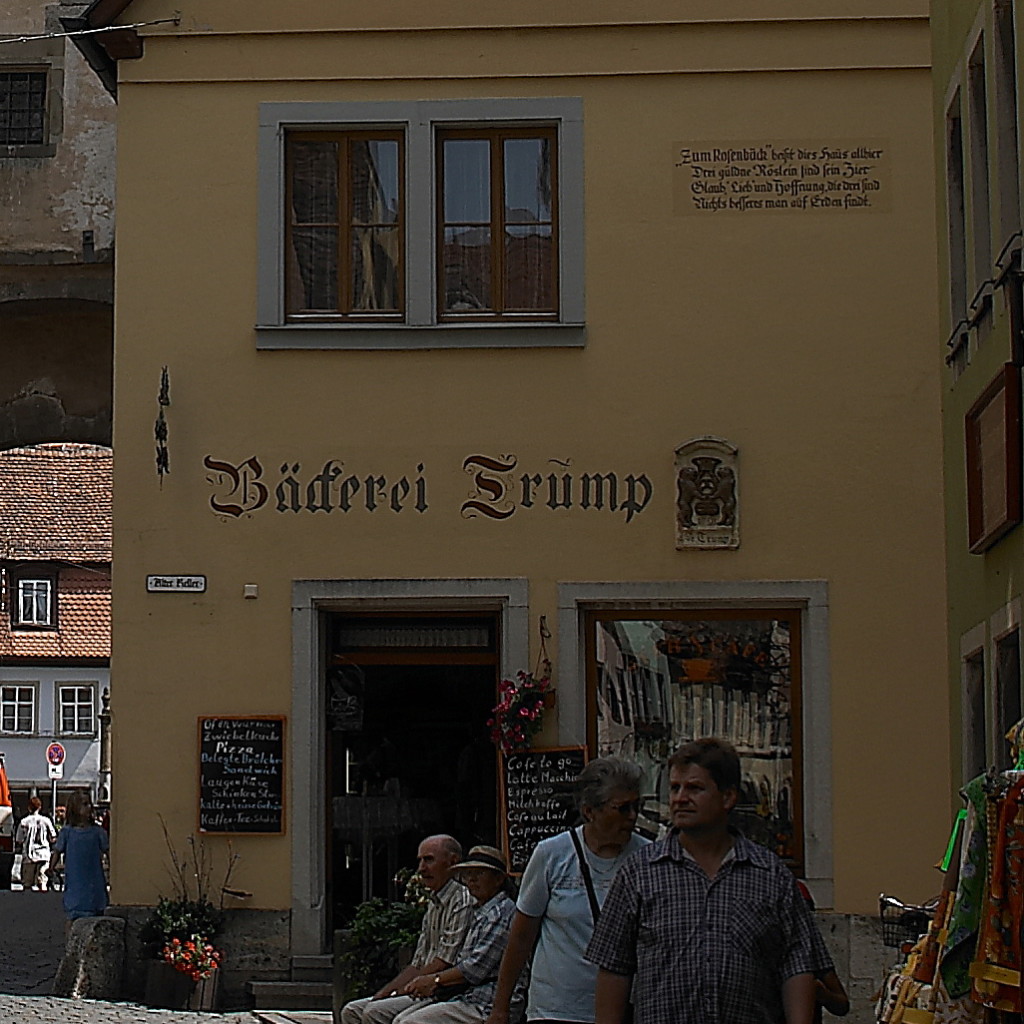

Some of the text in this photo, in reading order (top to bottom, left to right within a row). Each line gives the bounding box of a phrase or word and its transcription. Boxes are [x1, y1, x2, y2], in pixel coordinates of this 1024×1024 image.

[204, 453, 654, 524] Bäckerei Trump
[216, 741, 255, 754] Pizza
[540, 755, 552, 768] to
[557, 758, 572, 770] go
